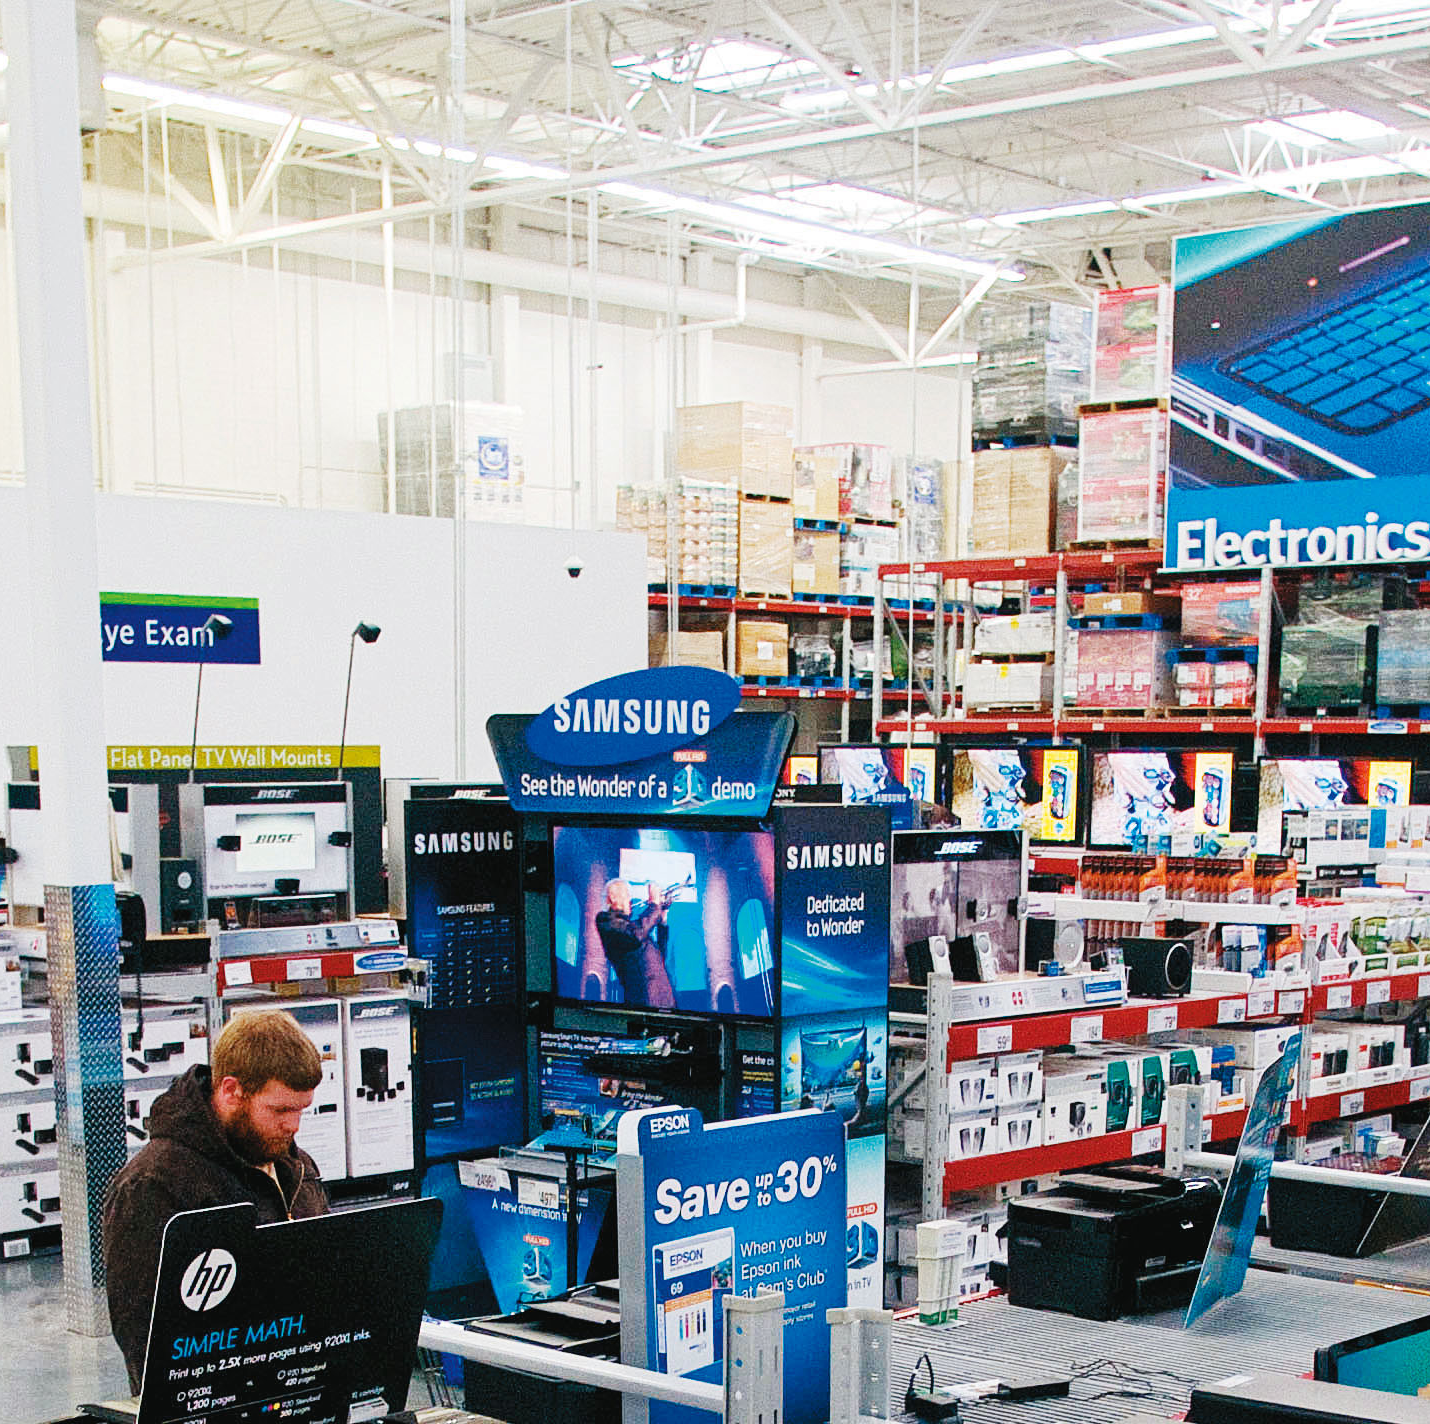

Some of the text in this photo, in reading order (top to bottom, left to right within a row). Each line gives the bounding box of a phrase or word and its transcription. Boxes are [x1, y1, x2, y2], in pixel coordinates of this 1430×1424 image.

[100, 617, 214, 650] ye Exam
[553, 698, 711, 736] SAMSUNG
[110, 748, 332, 768] Flat Panel TV Wall Mounts
[250, 788, 300, 800] BOSE
[450, 788, 492, 800] BOSE
[521, 774, 756, 800] See the Wonder of a demo
[248, 832, 303, 846] BOSE
[414, 830, 514, 855] SAMSUNG
[933, 840, 981, 855] BOSE
[786, 841, 886, 870] SAMSUNG
[806, 892, 865, 917] Dedicated
[806, 917, 865, 938] to Wonder
[354, 1005, 400, 1019] BOSE
[649, 1113, 690, 1134] EPSON
[653, 1172, 774, 1226] Save up to
[500, 1201, 561, 1222] new dimension
[739, 1228, 828, 1259] When you buy
[669, 1248, 704, 1267] EPSON
[740, 1254, 802, 1281] Epson ink
[180, 1248, 237, 1312] hp
[670, 1280, 684, 1296] 69
[796, 1271, 826, 1290] Club
[172, 1313, 307, 1361] SIMPLE MATH.
[169, 1365, 191, 1382] Print
[192, 1365, 206, 1379] up
[207, 1360, 216, 1373] to
[218, 1354, 242, 1372] 2.5X
[243, 1350, 267, 1367] more
[268, 1345, 298, 1364] pages
[298, 1339, 322, 1359] using
[211, 1392, 236, 1410] pages
